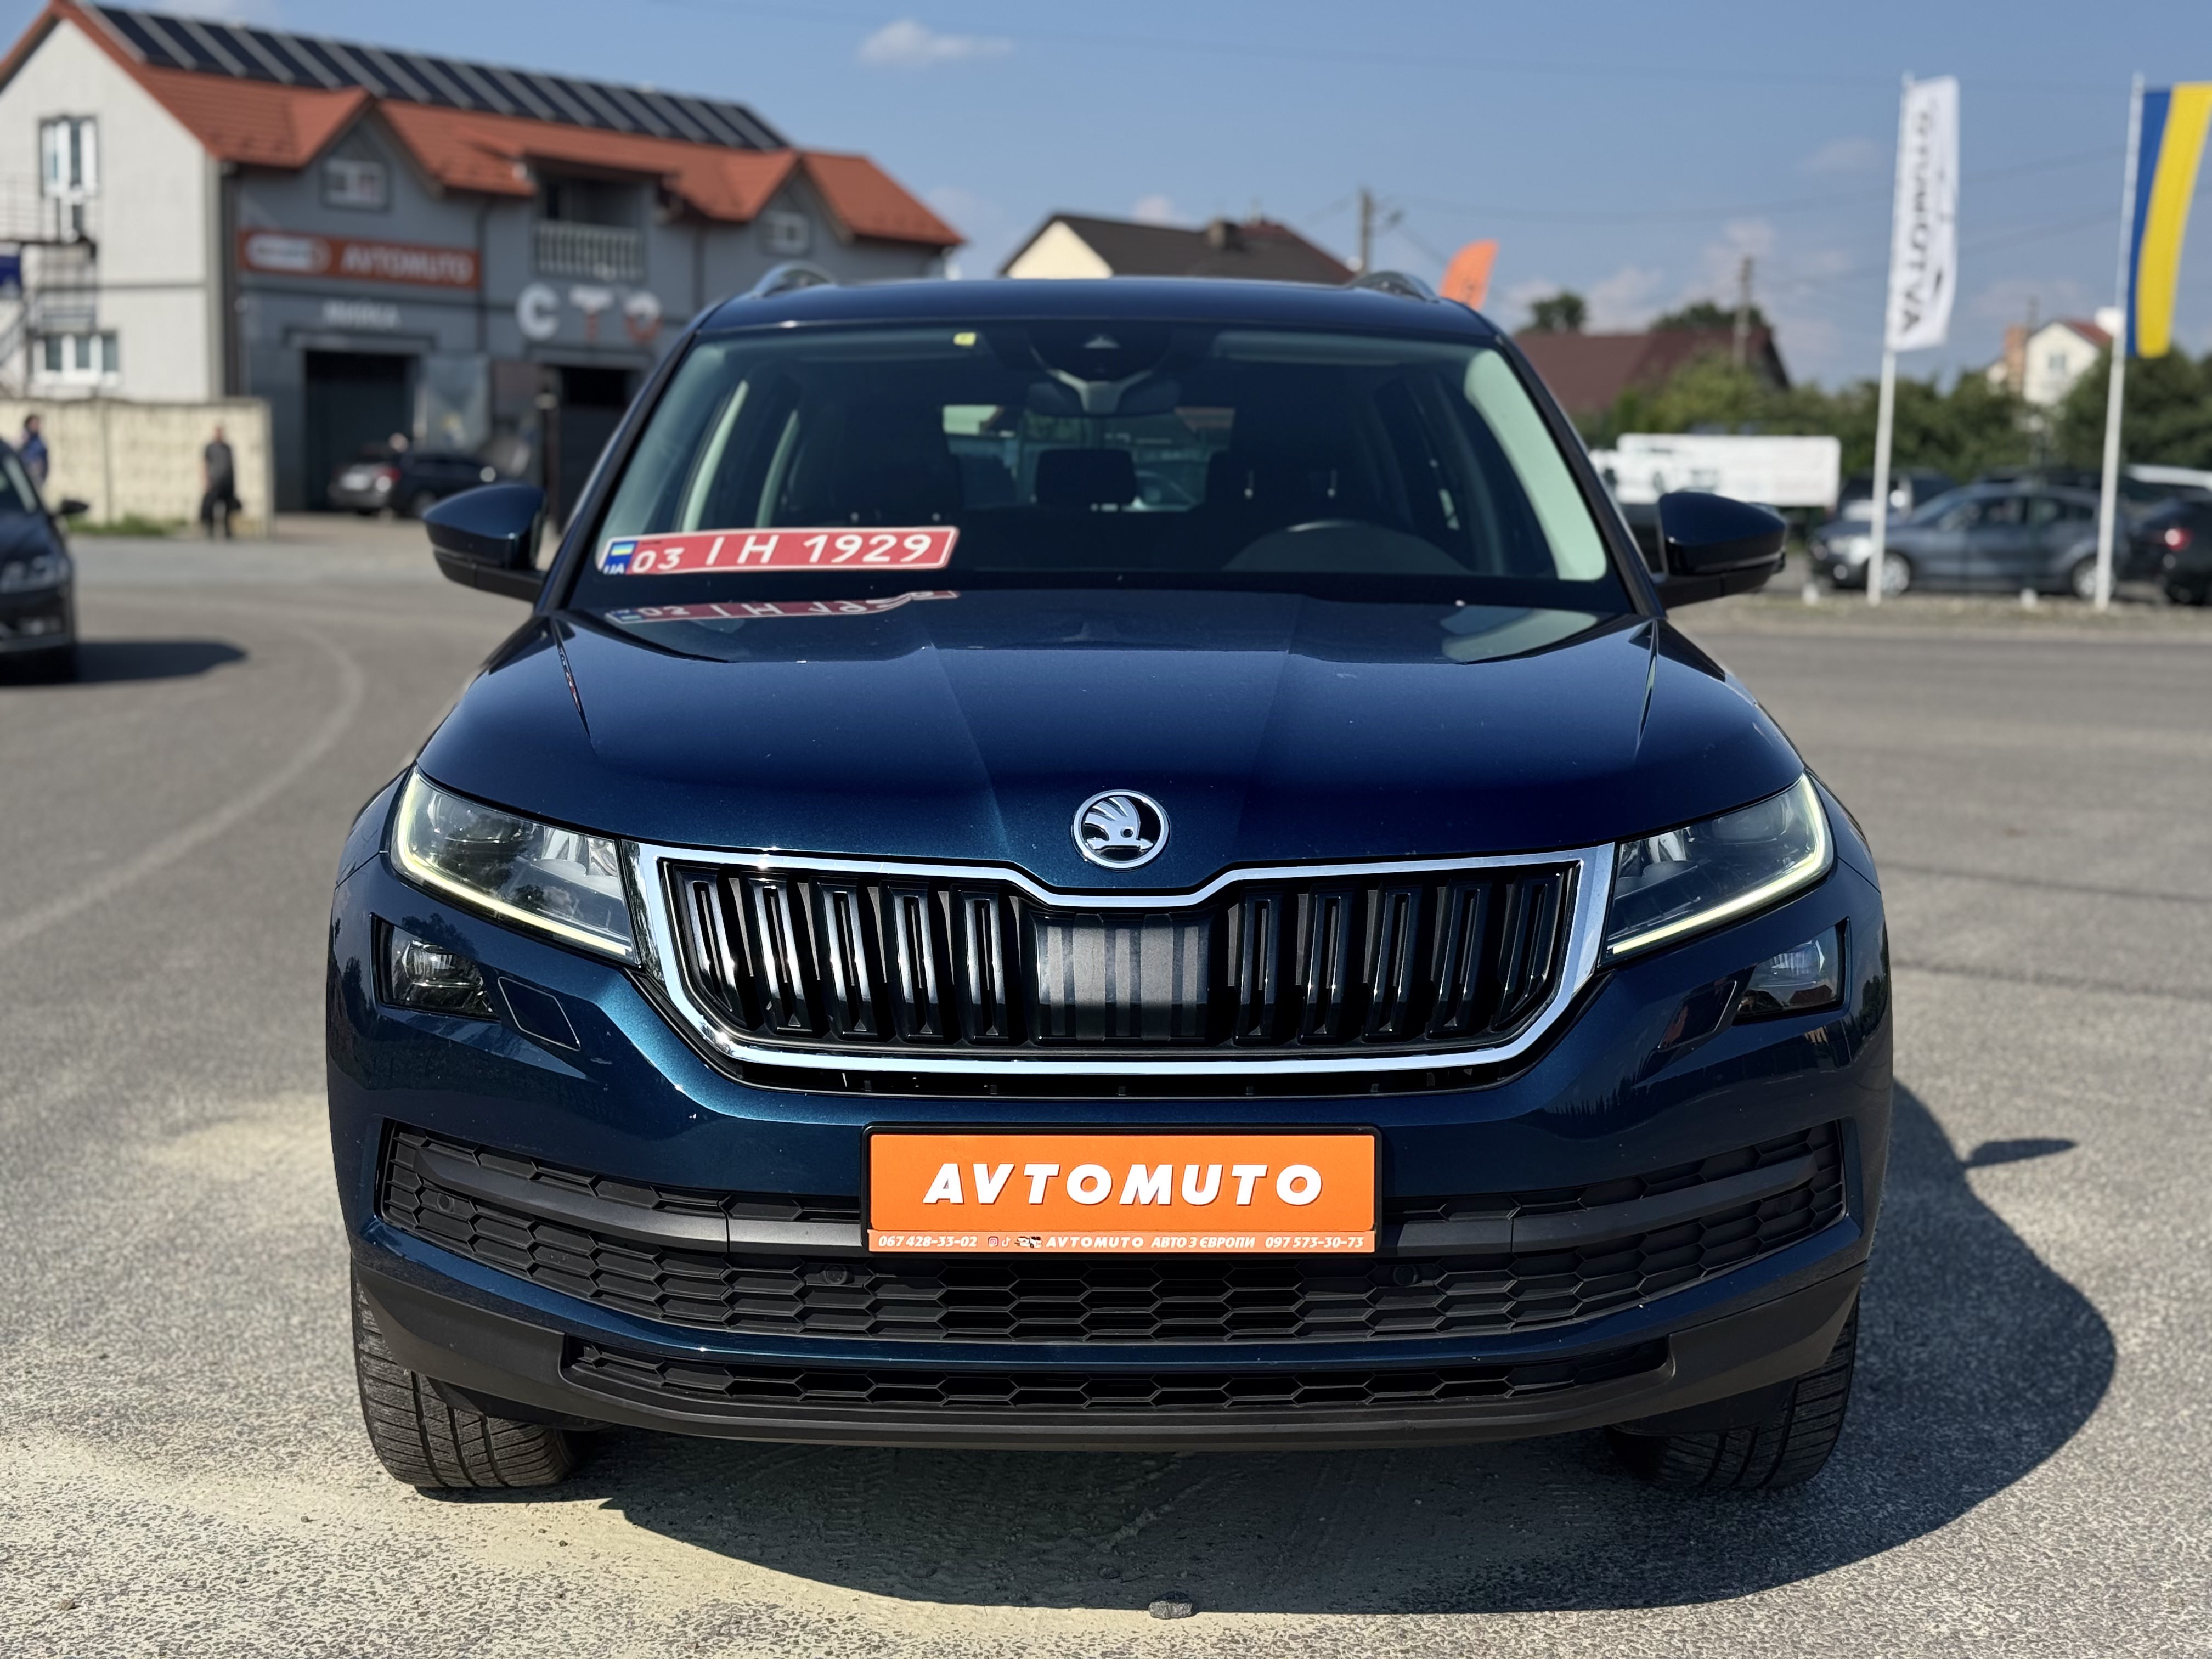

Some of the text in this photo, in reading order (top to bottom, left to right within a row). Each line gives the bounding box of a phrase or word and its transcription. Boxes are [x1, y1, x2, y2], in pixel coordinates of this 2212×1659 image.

[342, 245, 473, 283] AVTOMUTO
[632, 547, 685, 573] 03
[803, 534, 932, 563] 1929
[922, 1163, 1323, 1206] AVTOMUTO
[1046, 1236, 1144, 1248] AVTOMUTO
[1150, 1237, 1188, 1248] АВТО
[1199, 1237, 1256, 1248] ЄВРОПИ
